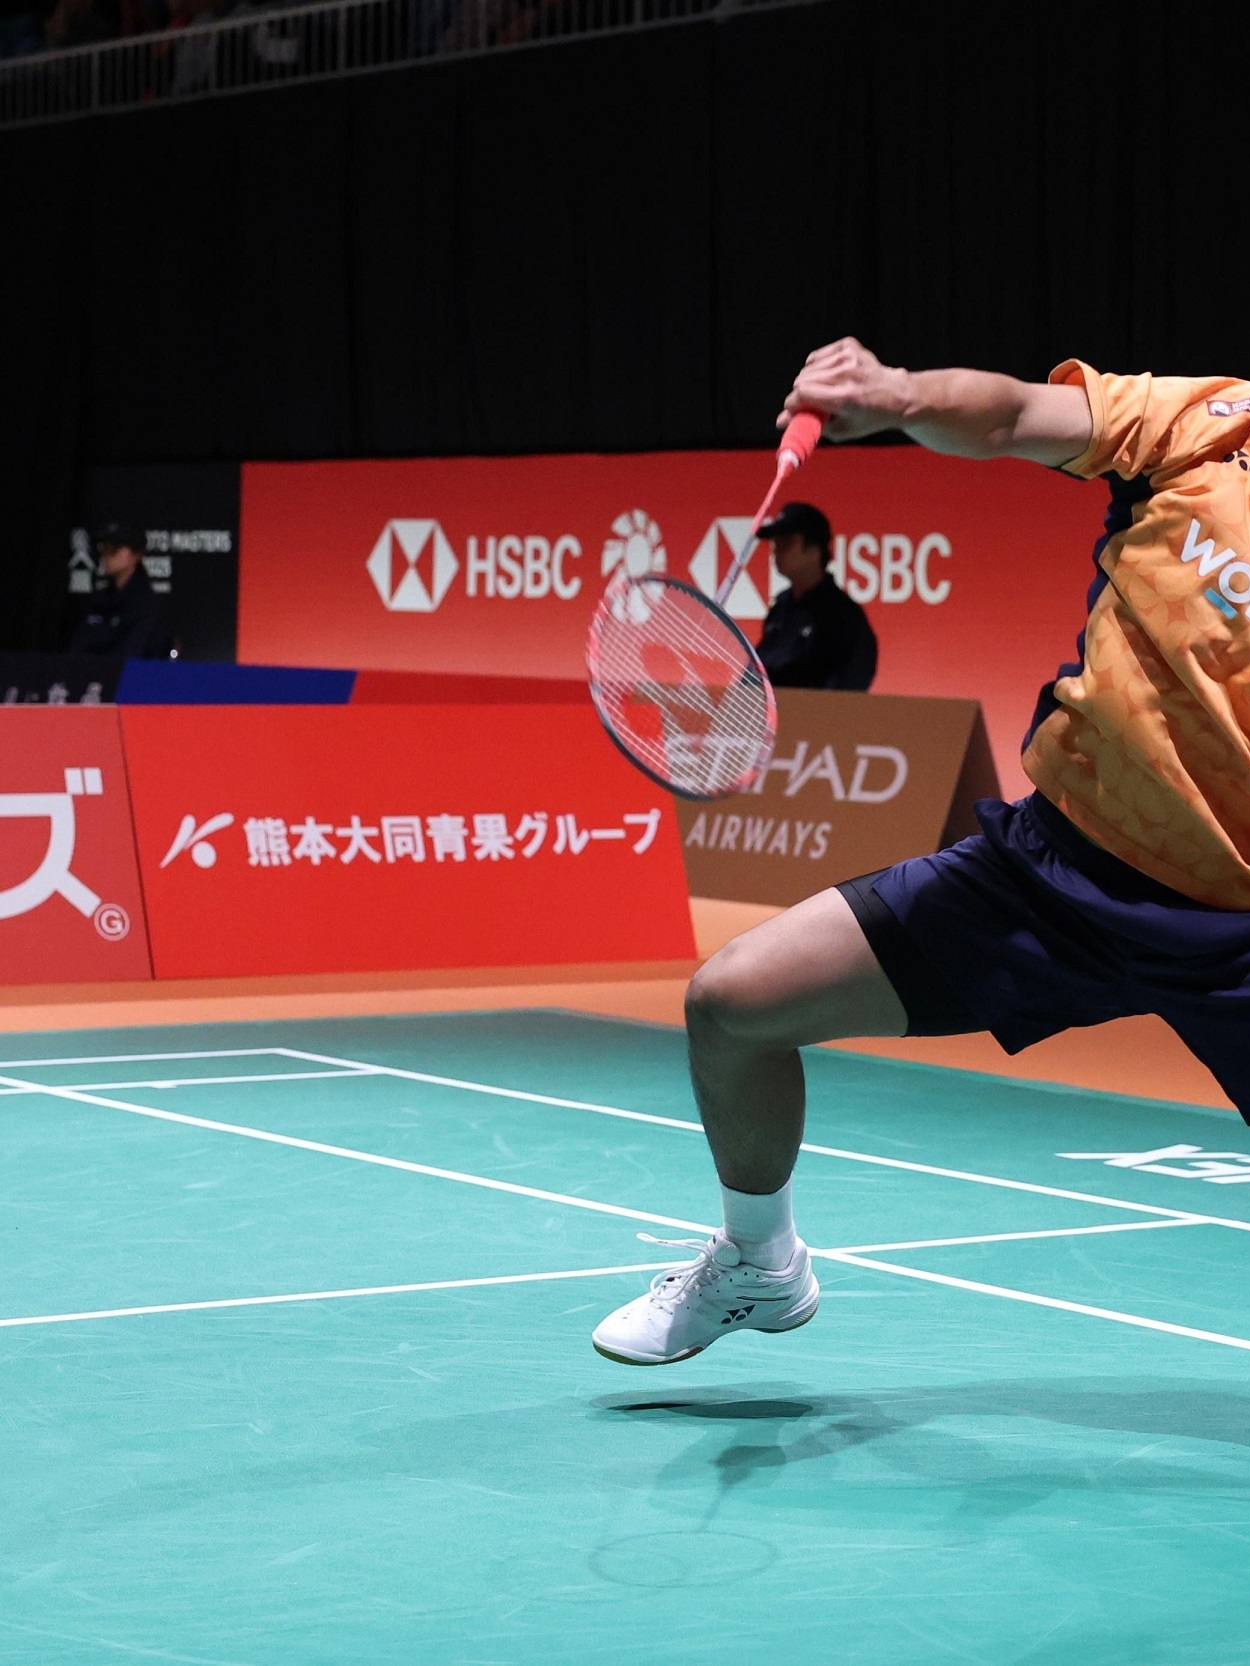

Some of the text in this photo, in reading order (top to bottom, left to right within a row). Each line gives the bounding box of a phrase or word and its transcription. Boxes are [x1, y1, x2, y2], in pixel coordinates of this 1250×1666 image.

[466, 534, 583, 600] HSBC
[243, 808, 662, 867] 熊本大同青果グループ
[685, 811, 833, 860] AIRWAYS
